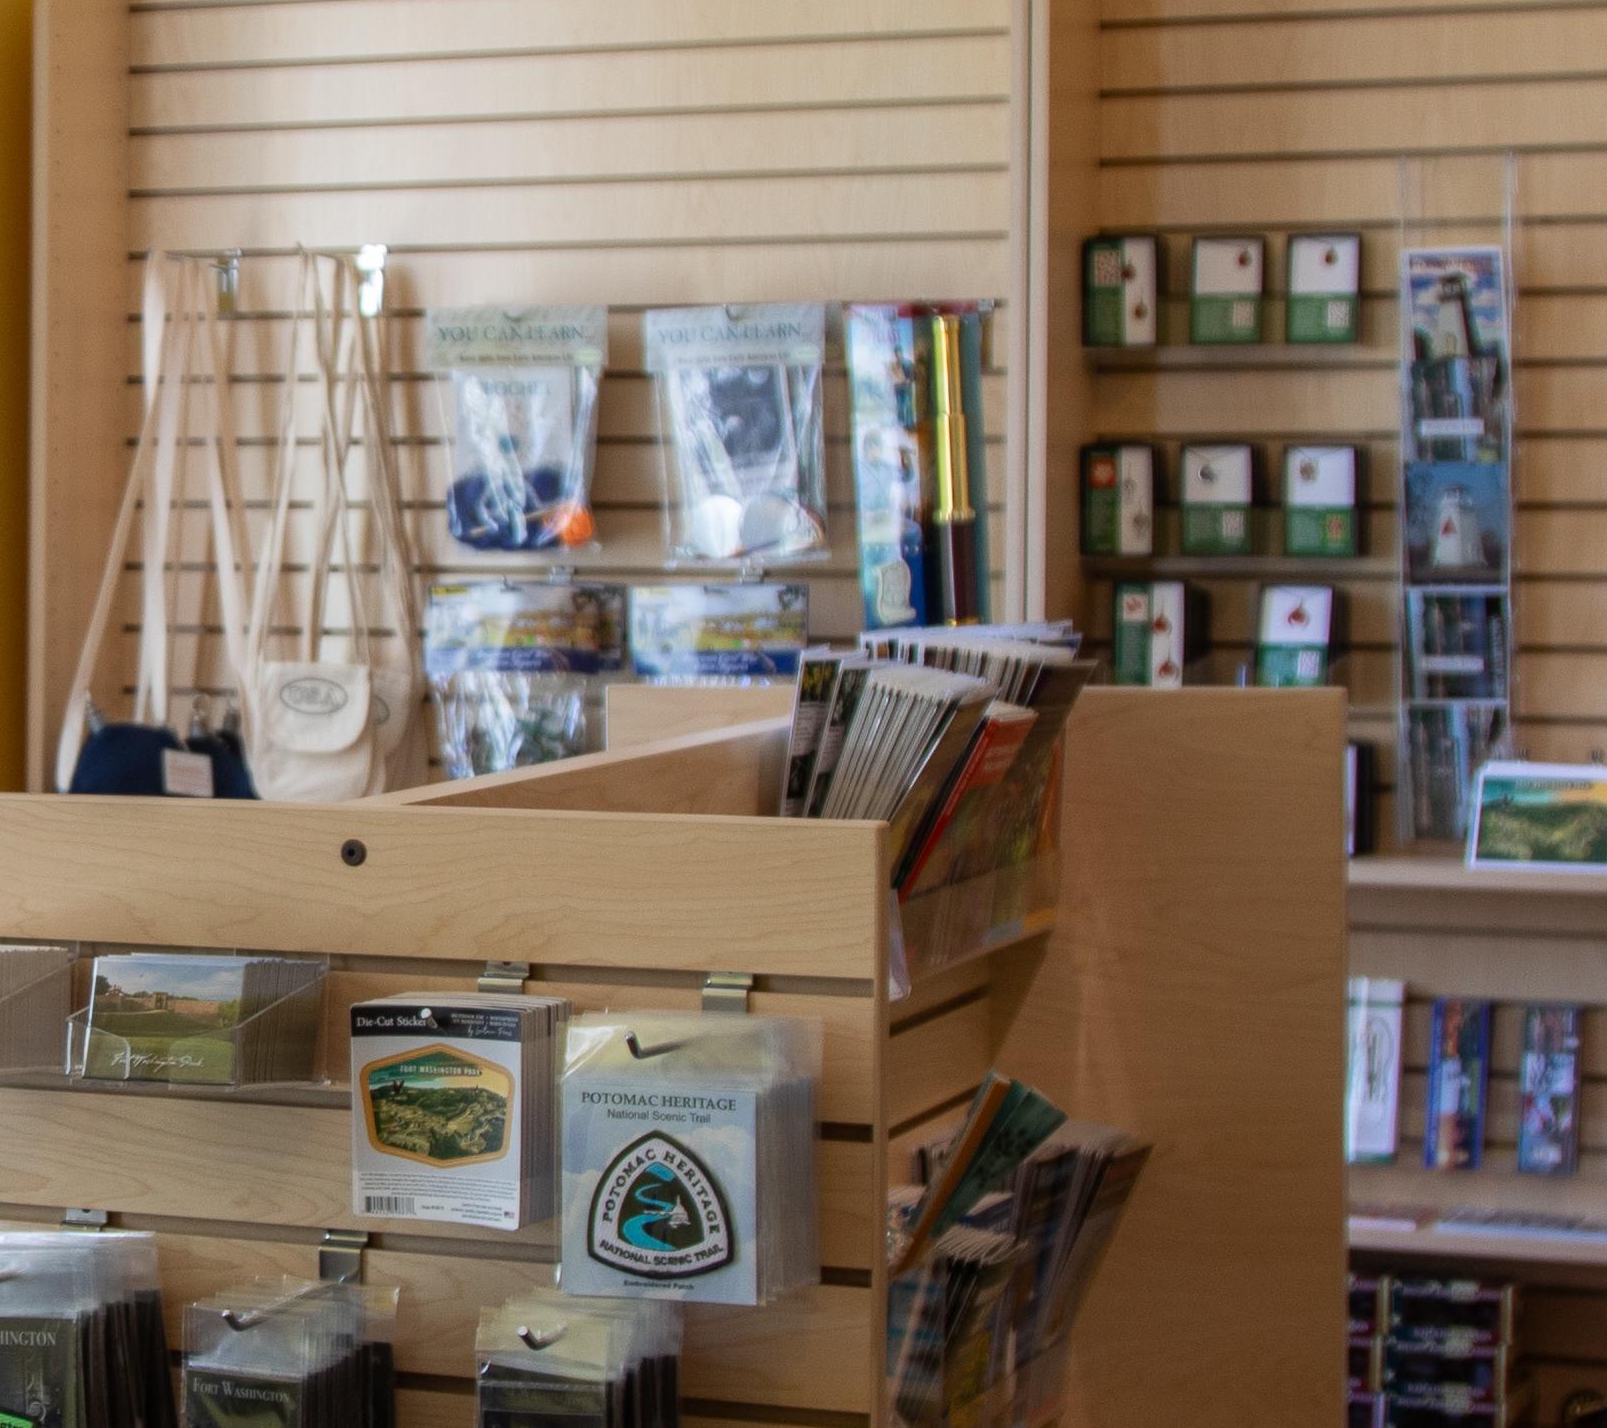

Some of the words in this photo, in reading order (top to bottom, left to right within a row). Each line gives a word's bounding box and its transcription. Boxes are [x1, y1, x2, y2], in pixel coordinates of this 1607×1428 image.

[437, 324, 480, 343] YOU
[482, 324, 525, 342] CAN
[356, 1015, 393, 1028] Die-Cut
[580, 1091, 660, 1108] POTOMAC
[661, 1094, 737, 1112] HERITAGE
[606, 1108, 649, 1121] National
[651, 1110, 688, 1123] Scenic
[688, 1112, 712, 1125] Trail
[602, 1147, 657, 1225] POTOMAC
[662, 1149, 722, 1238] HERITAGE
[599, 1238, 653, 1267] NATIONAL
[652, 1252, 693, 1267] SCENIC
[693, 1244, 725, 1265] TRAIL
